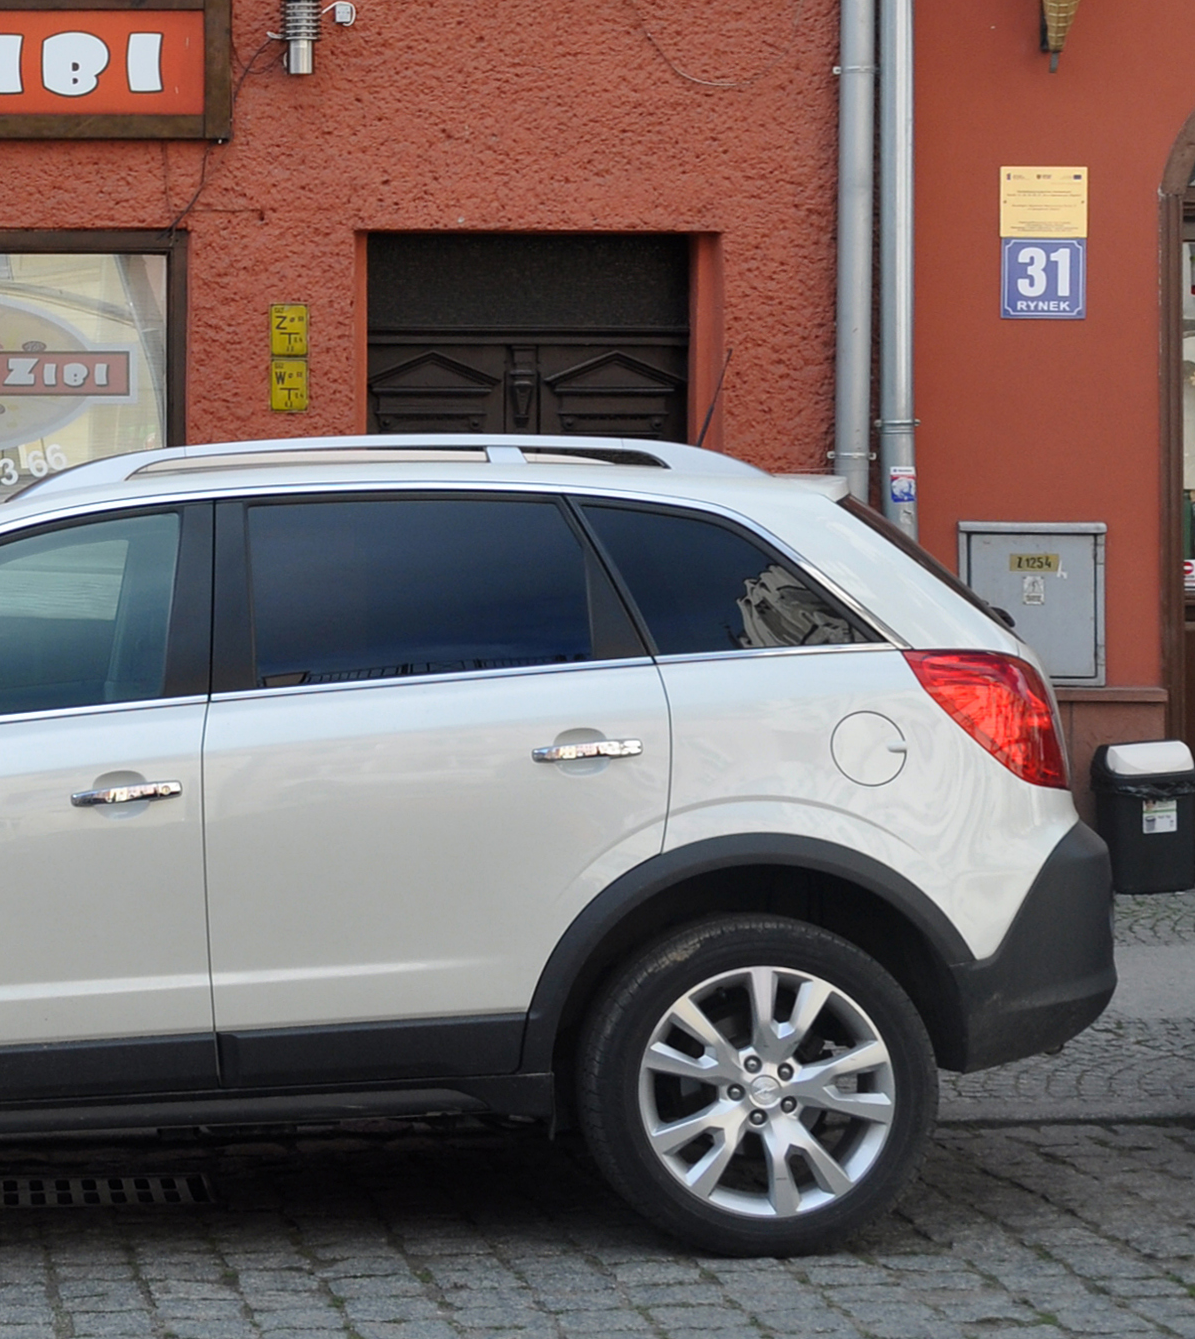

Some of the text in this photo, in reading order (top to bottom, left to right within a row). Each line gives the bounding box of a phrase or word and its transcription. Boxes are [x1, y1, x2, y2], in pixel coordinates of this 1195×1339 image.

[1017, 247, 1070, 297] 31
[1017, 301, 1070, 311] RYNEK
[275, 316, 287, 329] Z
[3, 357, 109, 387] ZIBI
[275, 371, 286, 385] W
[27, 443, 68, 478] 66
